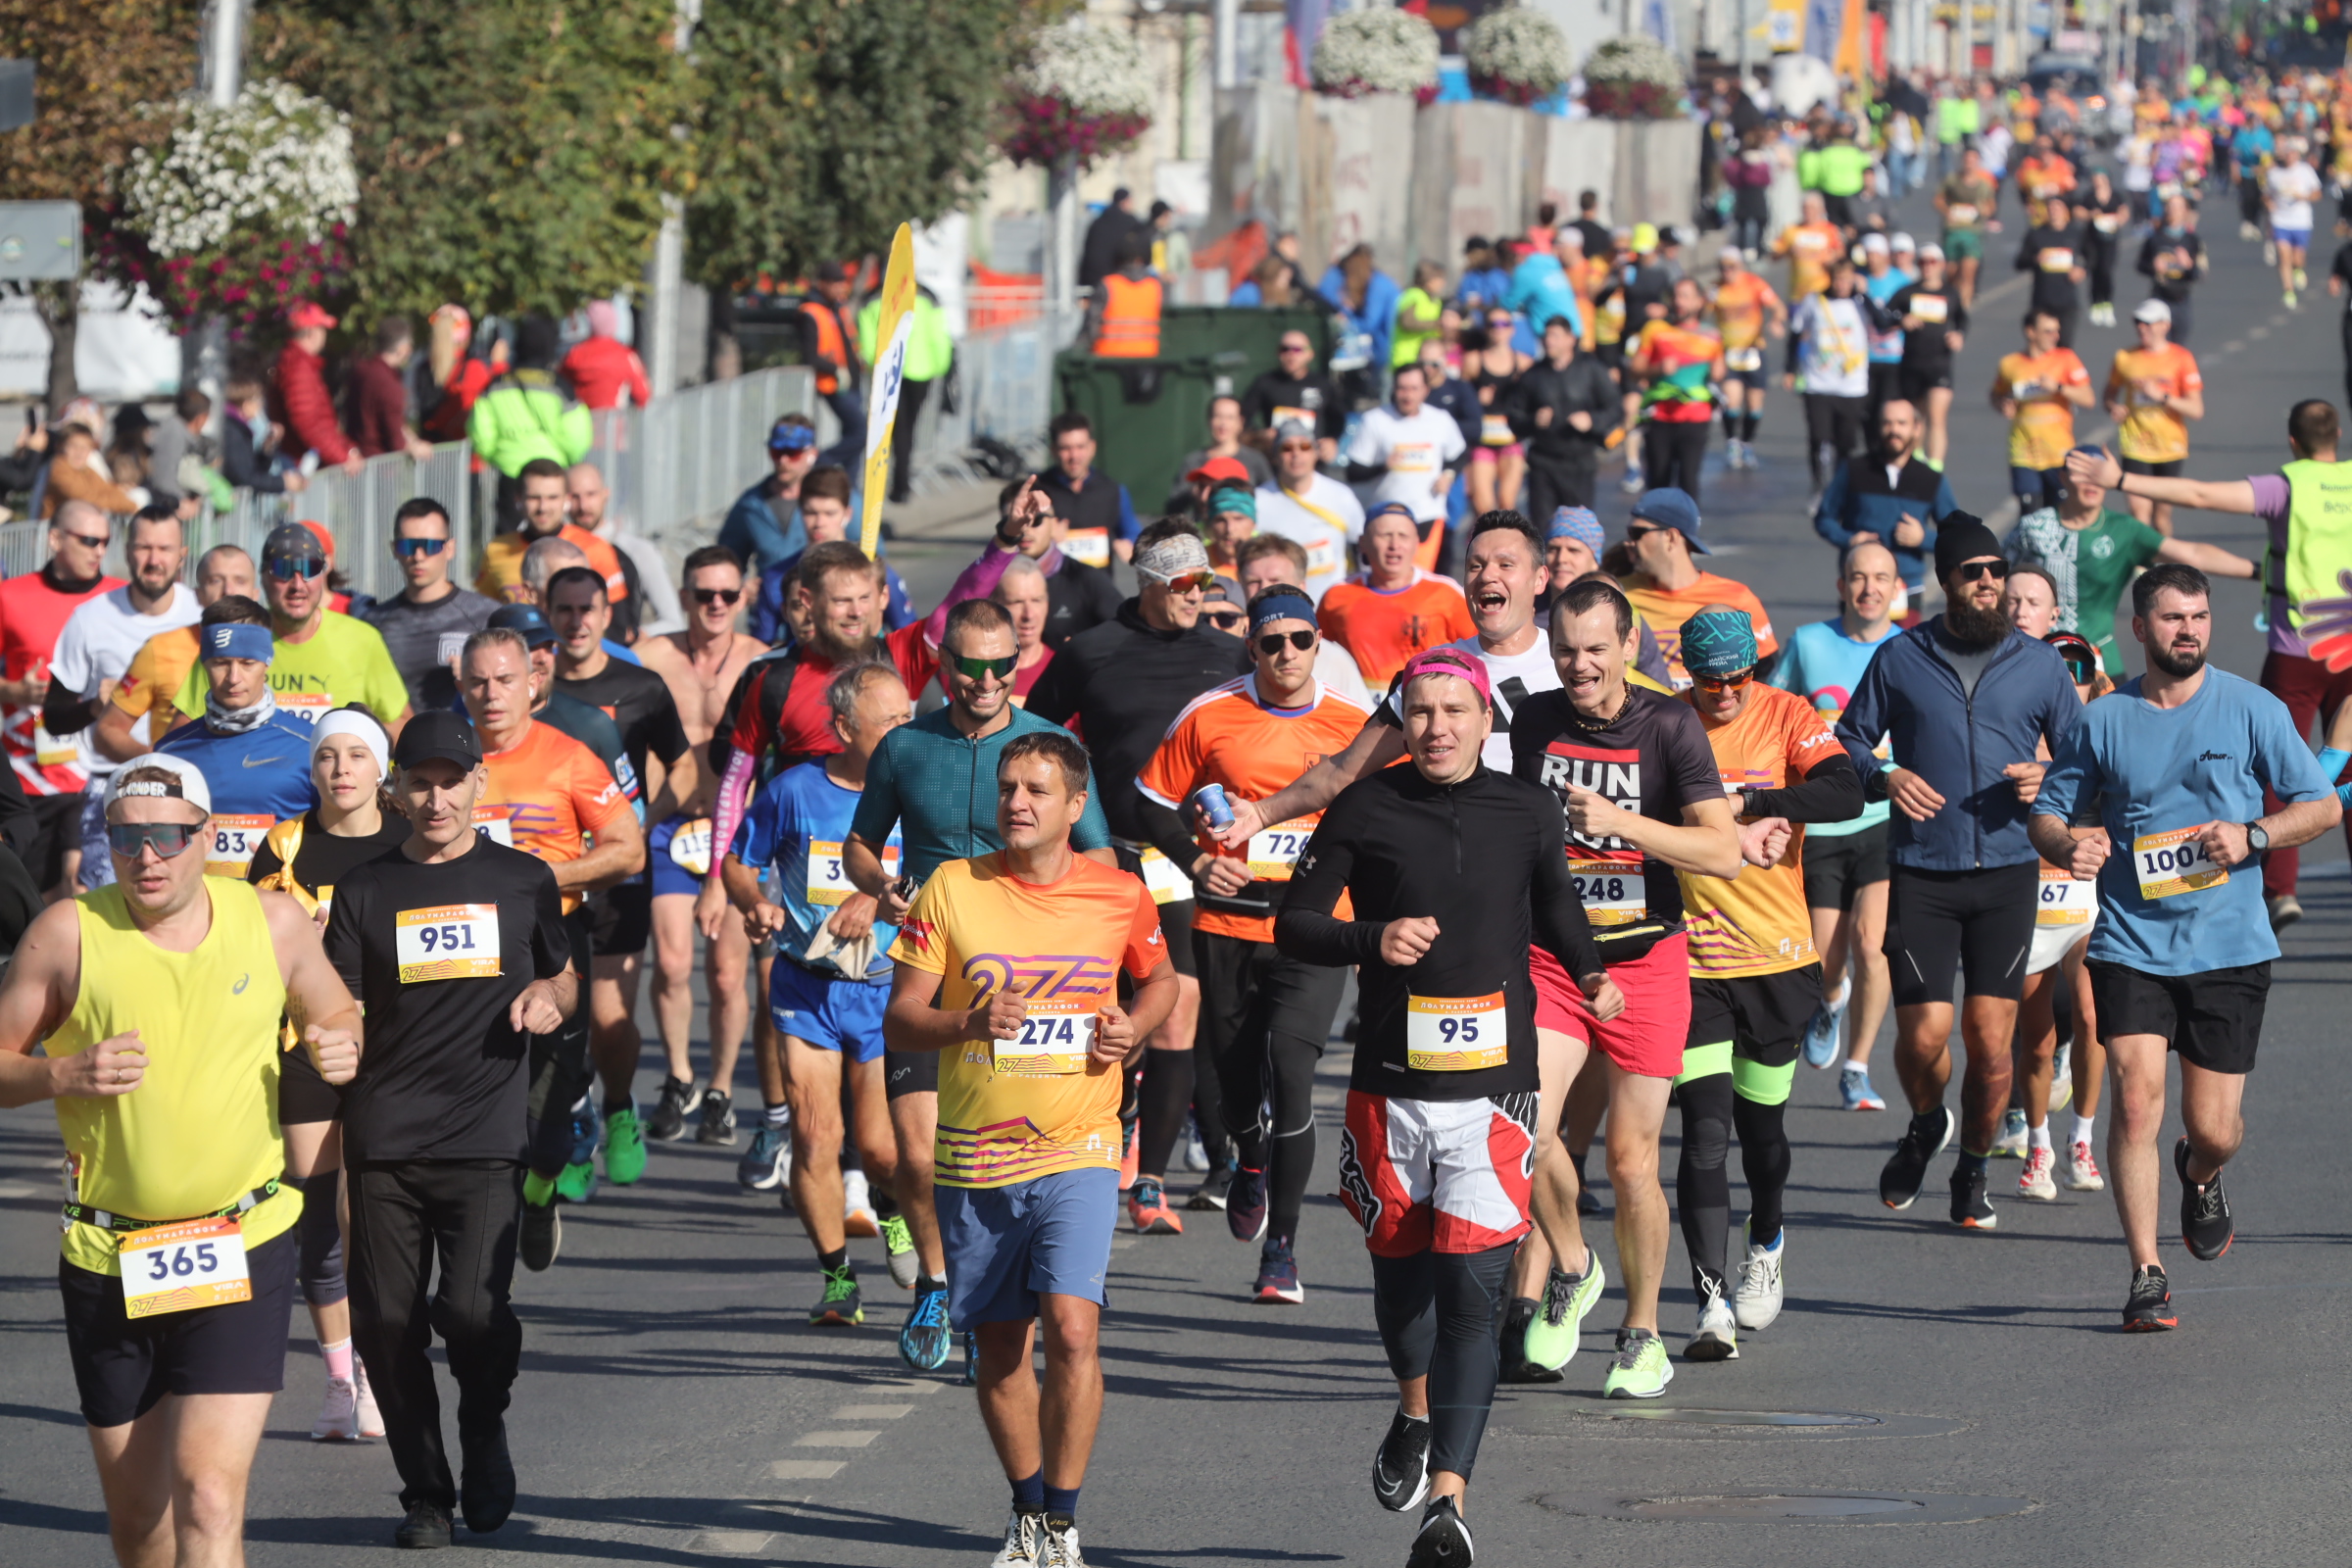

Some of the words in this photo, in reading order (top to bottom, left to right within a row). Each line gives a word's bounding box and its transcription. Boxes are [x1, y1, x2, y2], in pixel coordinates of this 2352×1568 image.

[1540, 754, 1642, 798] RUN
[215, 831, 246, 854] 83
[1573, 877, 1625, 901] 248
[419, 924, 475, 953] 951
[1421, 1001, 1491, 1010] ПОЛУМАРАФОН
[1019, 1018, 1074, 1045] 274
[1439, 1017, 1479, 1043] 95
[1481, 1048, 1503, 1057] VIRA
[133, 1225, 218, 1245] ПОЛУМАРАФОН
[146, 1243, 218, 1280] 365
[213, 1280, 244, 1292] VIRA
